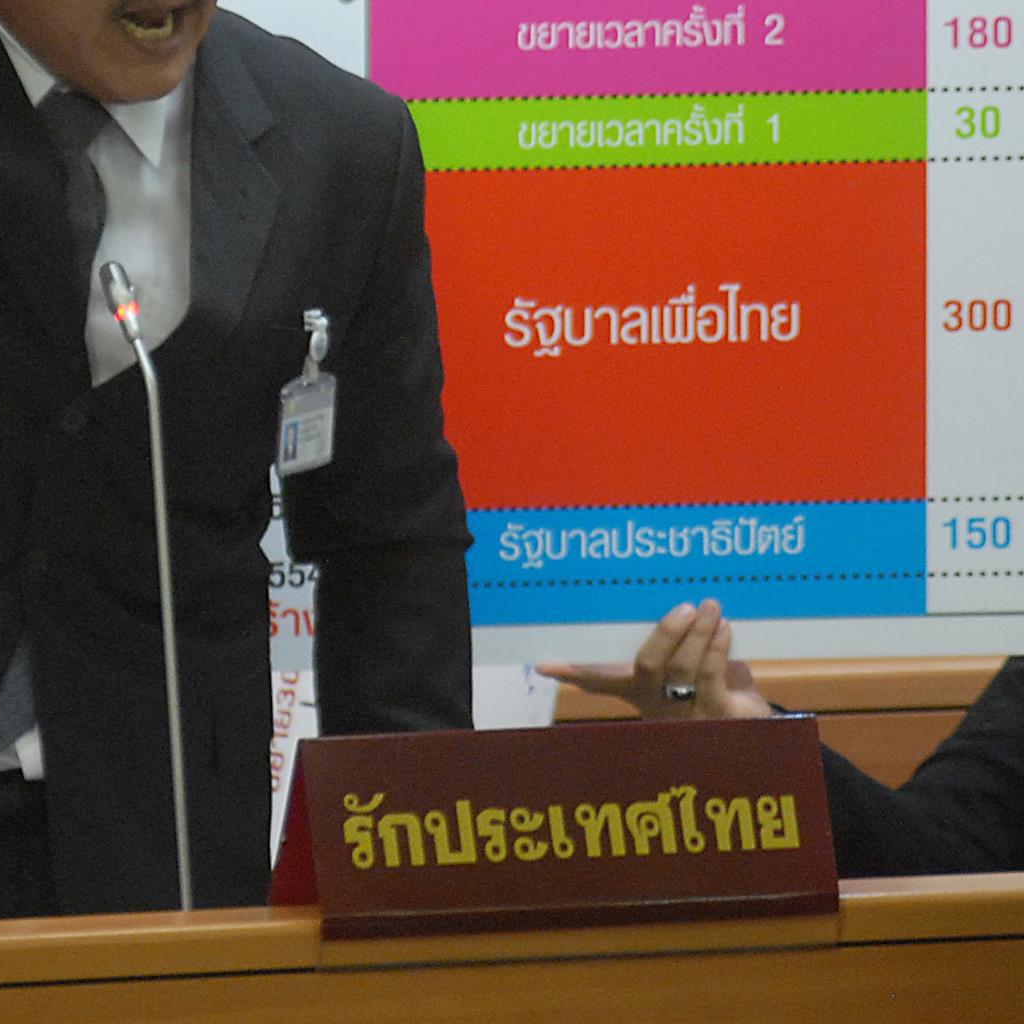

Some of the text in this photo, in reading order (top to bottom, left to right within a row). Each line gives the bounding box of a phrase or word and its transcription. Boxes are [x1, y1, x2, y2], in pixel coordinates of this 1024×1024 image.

[517, 4, 786, 51] ขยายเวลาครั้งที่ 2
[943, 15, 1013, 49] 180
[517, 103, 780, 149] ขยายเวลาครั้งที่ 1
[955, 105, 1001, 139] 30
[503, 283, 801, 357] รัฐบาลเพื่อไทย
[943, 299, 1013, 333] 300
[498, 515, 806, 569] รัฐบาลประชาธิปัตย์
[942, 516, 1012, 550] 150
[342, 784, 802, 870] รักประเทศไทย
